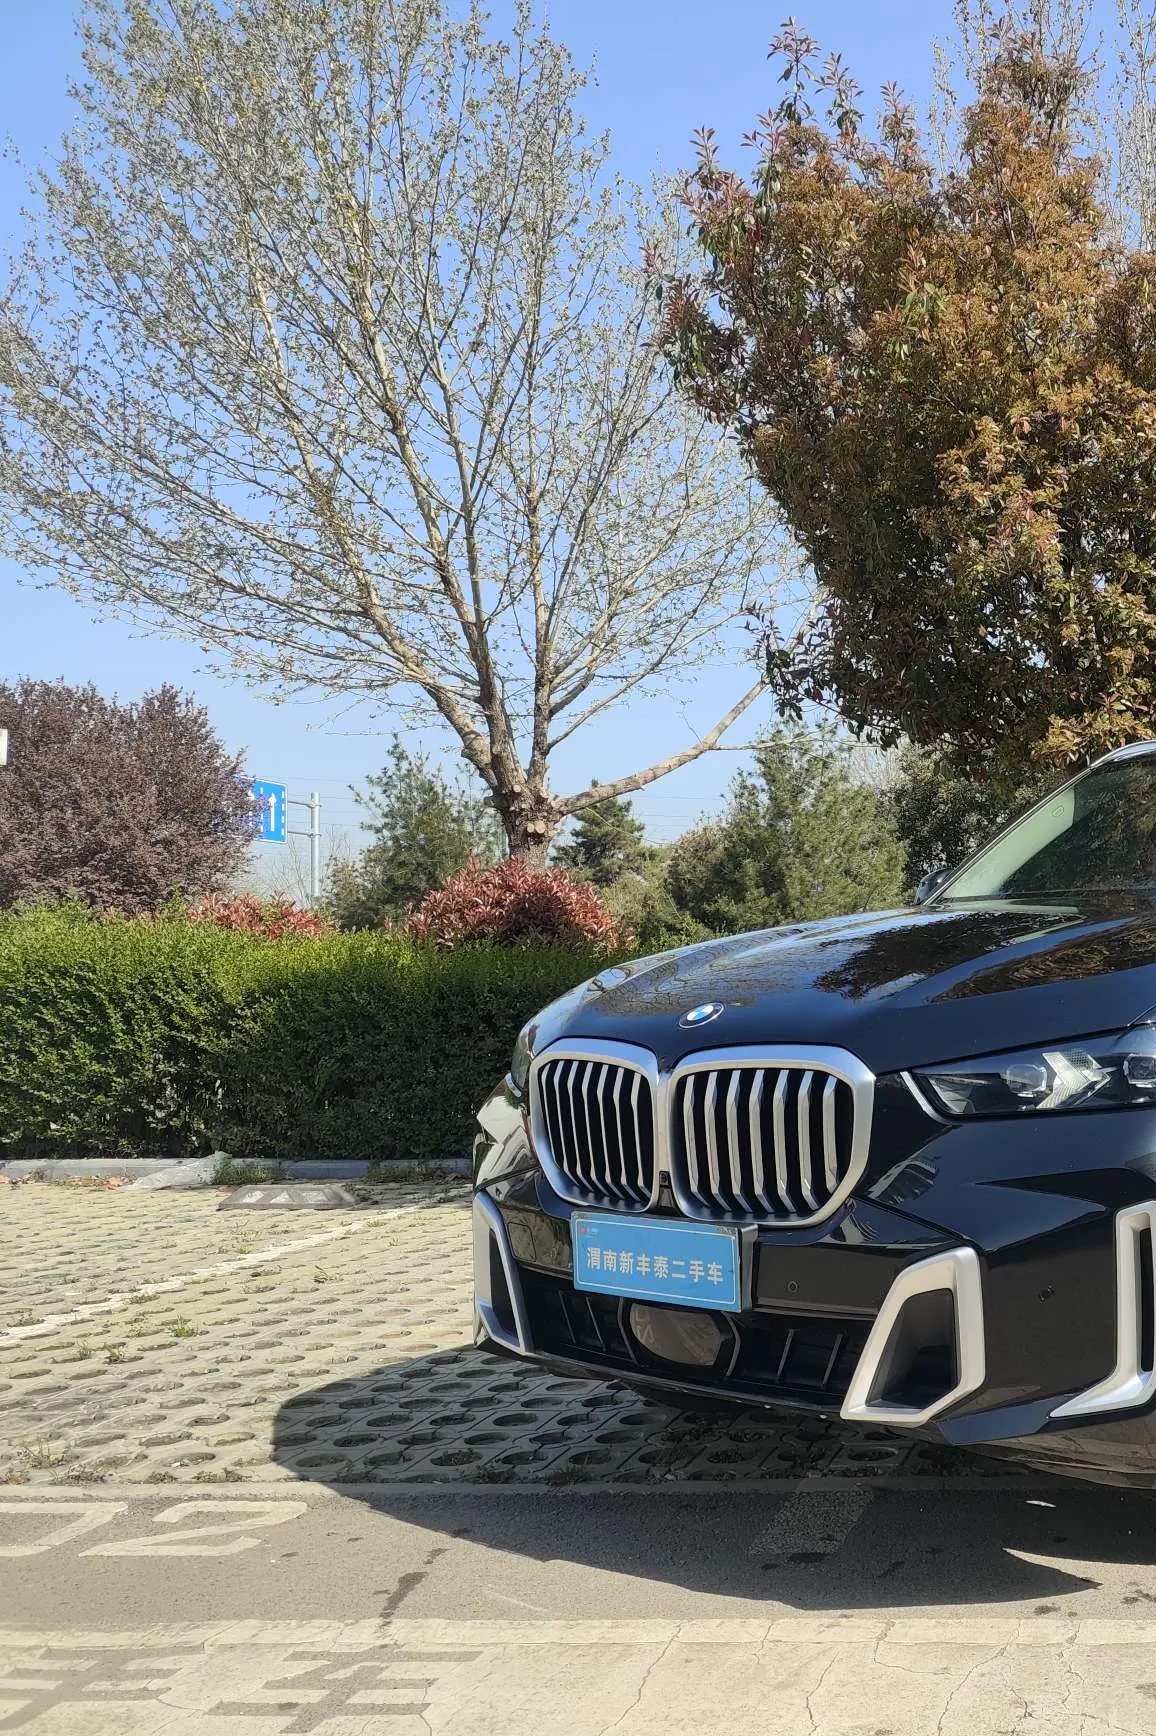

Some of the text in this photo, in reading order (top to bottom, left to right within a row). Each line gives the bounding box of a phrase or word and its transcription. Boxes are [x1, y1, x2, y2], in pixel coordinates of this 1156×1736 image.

[586, 1246, 724, 1285] 渭南新丰泰二手车
